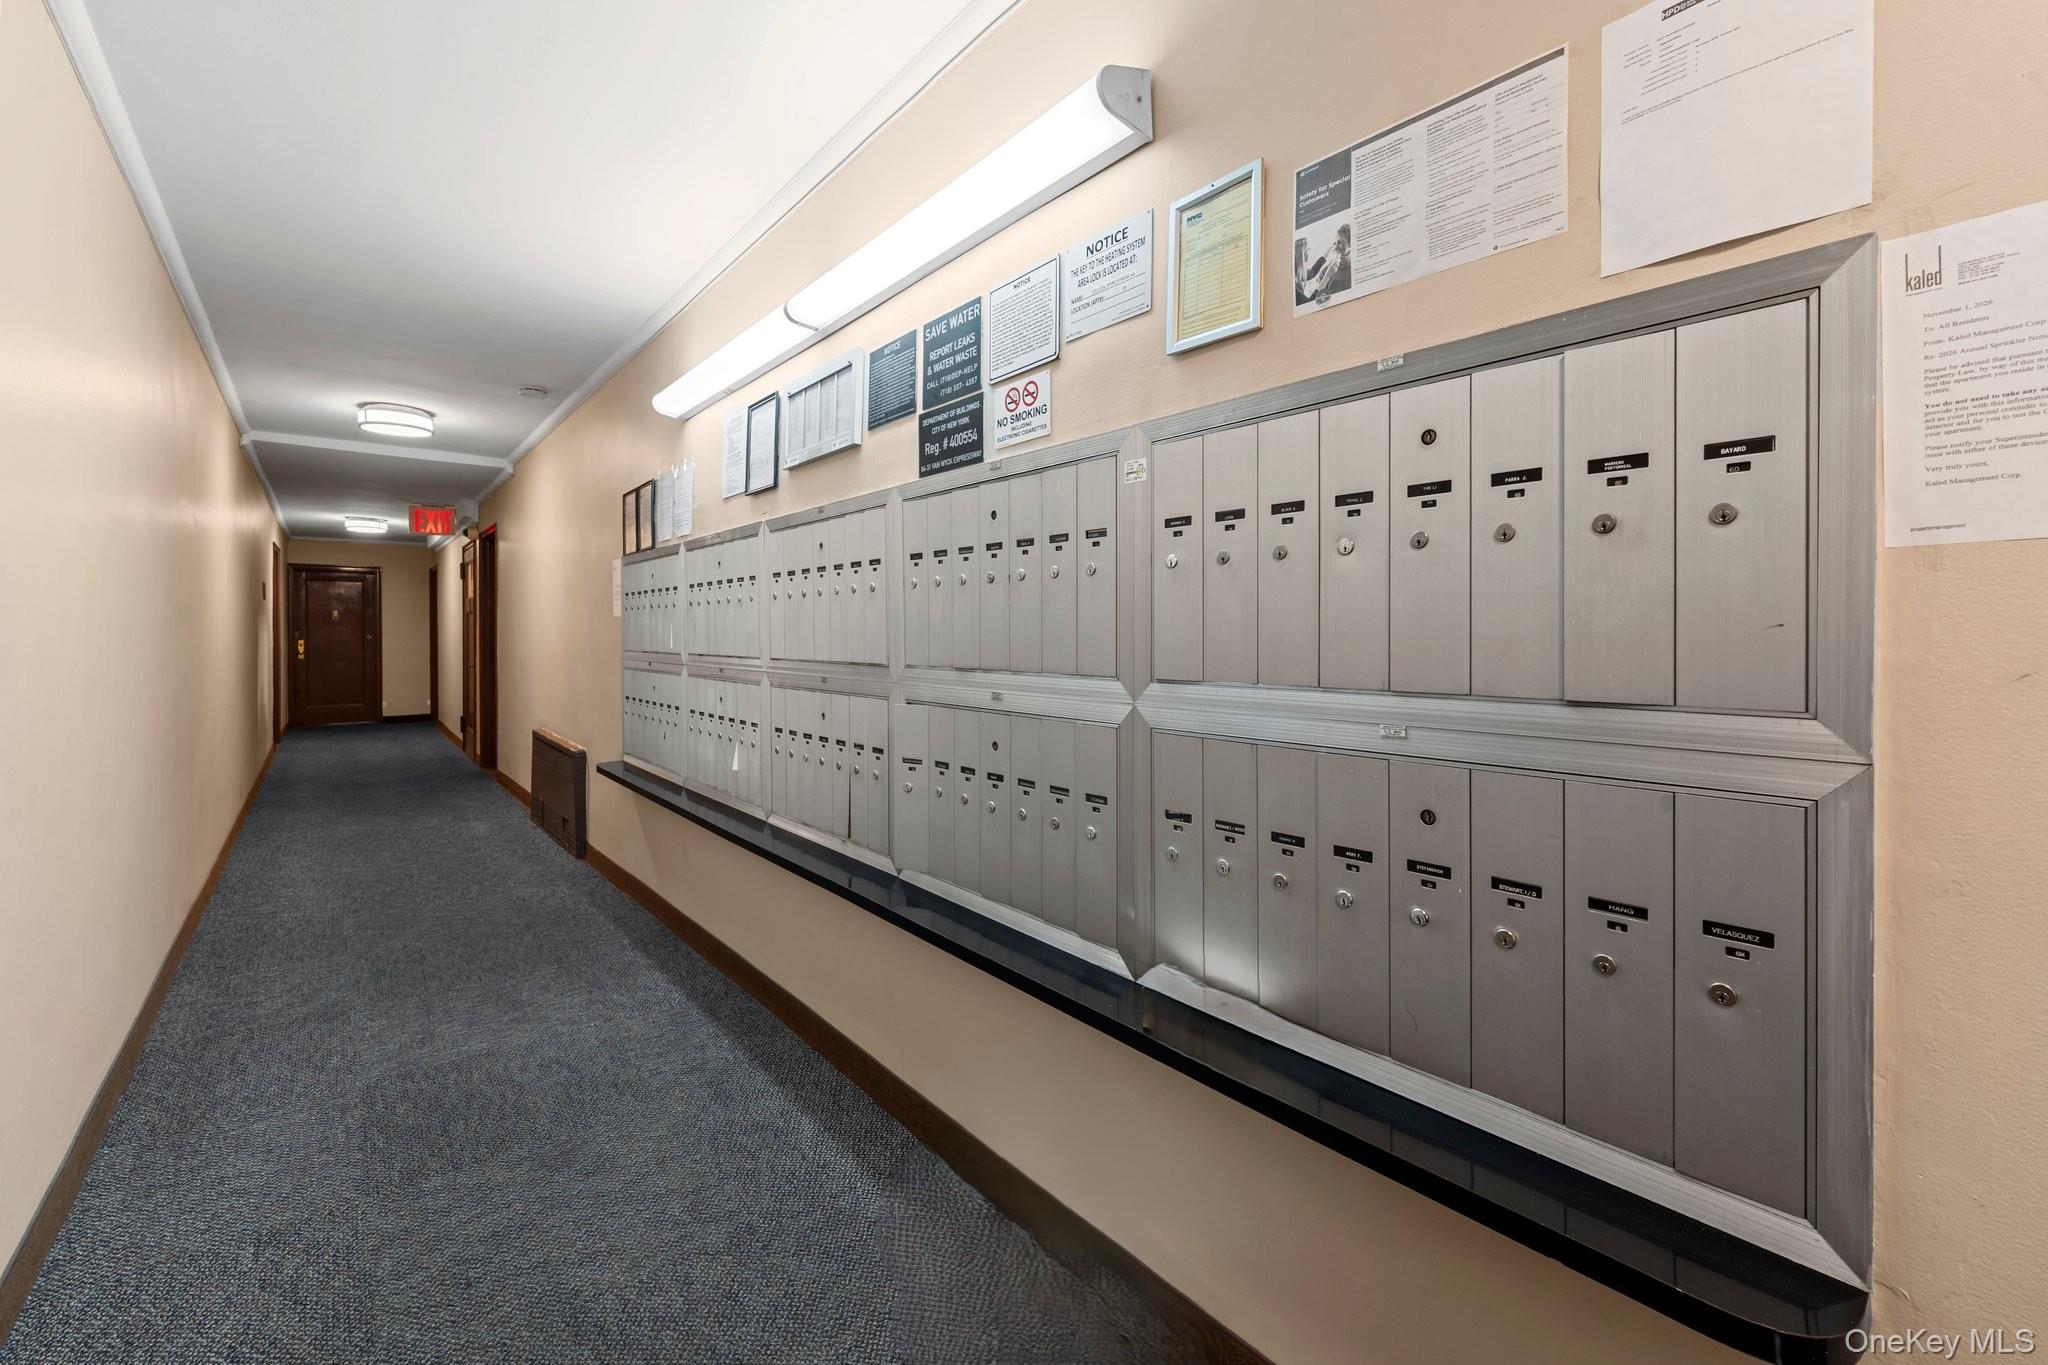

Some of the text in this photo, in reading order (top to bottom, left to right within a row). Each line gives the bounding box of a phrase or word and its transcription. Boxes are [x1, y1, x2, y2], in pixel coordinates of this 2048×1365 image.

[1662, 5, 1680, 20] HPD
[1300, 189, 1317, 200] Safety
[1329, 174, 1350, 188] Special
[1300, 192, 1329, 207] Customers
[1086, 226, 1128, 257] NOTICE
[1071, 236, 1146, 278] THE KEY TO THE HEATING SYSTEM
[1078, 276, 1089, 288] AREA
[1090, 272, 1101, 283] LOCK
[1102, 268, 1106, 277] IS
[1107, 259, 1128, 275] LOCATED
[1905, 245, 1942, 292] kaled
[1013, 276, 1031, 288] NOTICE
[1071, 303, 1090, 315] LOCATION
[1923, 307, 1962, 319] November
[1974, 299, 1993, 308] 2026
[925, 304, 980, 341] SAVE WATER
[1952, 316, 1990, 327] Residents
[1923, 338, 1946, 347] From:
[1948, 333, 1971, 342] Kaled
[1974, 323, 2023, 337] Management
[884, 341, 900, 355] NOTICE
[929, 332, 975, 362] REPORT LEAKS
[1960, 344, 1987, 353] Annual
[1990, 338, 2026, 349] Sprinkler
[927, 346, 977, 376] & WATER WASTE
[1960, 358, 1990, 368] advised
[2008, 350, 2043, 362] pursuant
[966, 376, 978, 386] 4357
[1924, 372, 1955, 382] Property
[1958, 368, 1977, 376] Law,
[1953, 373, 1992, 384] apartment
[927, 380, 939, 390] CALL
[1924, 388, 1952, 396] system.
[2002, 390, 2020, 398] take
[922, 412, 949, 427] DEPARTMENT
[956, 401, 980, 415] BUILDINGS
[997, 404, 1048, 429] NO SMOKING
[1924, 409, 1952, 418] provide
[1966, 408, 1999, 419] personal
[2001, 404, 2037, 413] reminder
[931, 425, 941, 434] CITY
[947, 420, 957, 430] NEW
[957, 416, 970, 427] YORK
[1011, 420, 1032, 431] INCLUDING
[1925, 423, 1954, 431] detector
[1943, 425, 1983, 436] apartment.
[997, 424, 1047, 443] ELECTRONIC CIGARETTES
[924, 428, 978, 456] Reg. # 400554
[1925, 443, 1948, 451] Please
[1950, 440, 1973, 449] notify
[1720, 446, 1746, 454] BAYARD
[932, 462, 940, 471] VAN
[953, 450, 982, 464] EXPRESSWAY
[1945, 462, 1963, 471] truly
[1925, 479, 1947, 487] Kaled
[1949, 474, 1998, 485] Management
[415, 508, 453, 535] EXIT
[1608, 904, 1634, 914] HANG
[1712, 927, 1760, 942] VELASQUEZ
